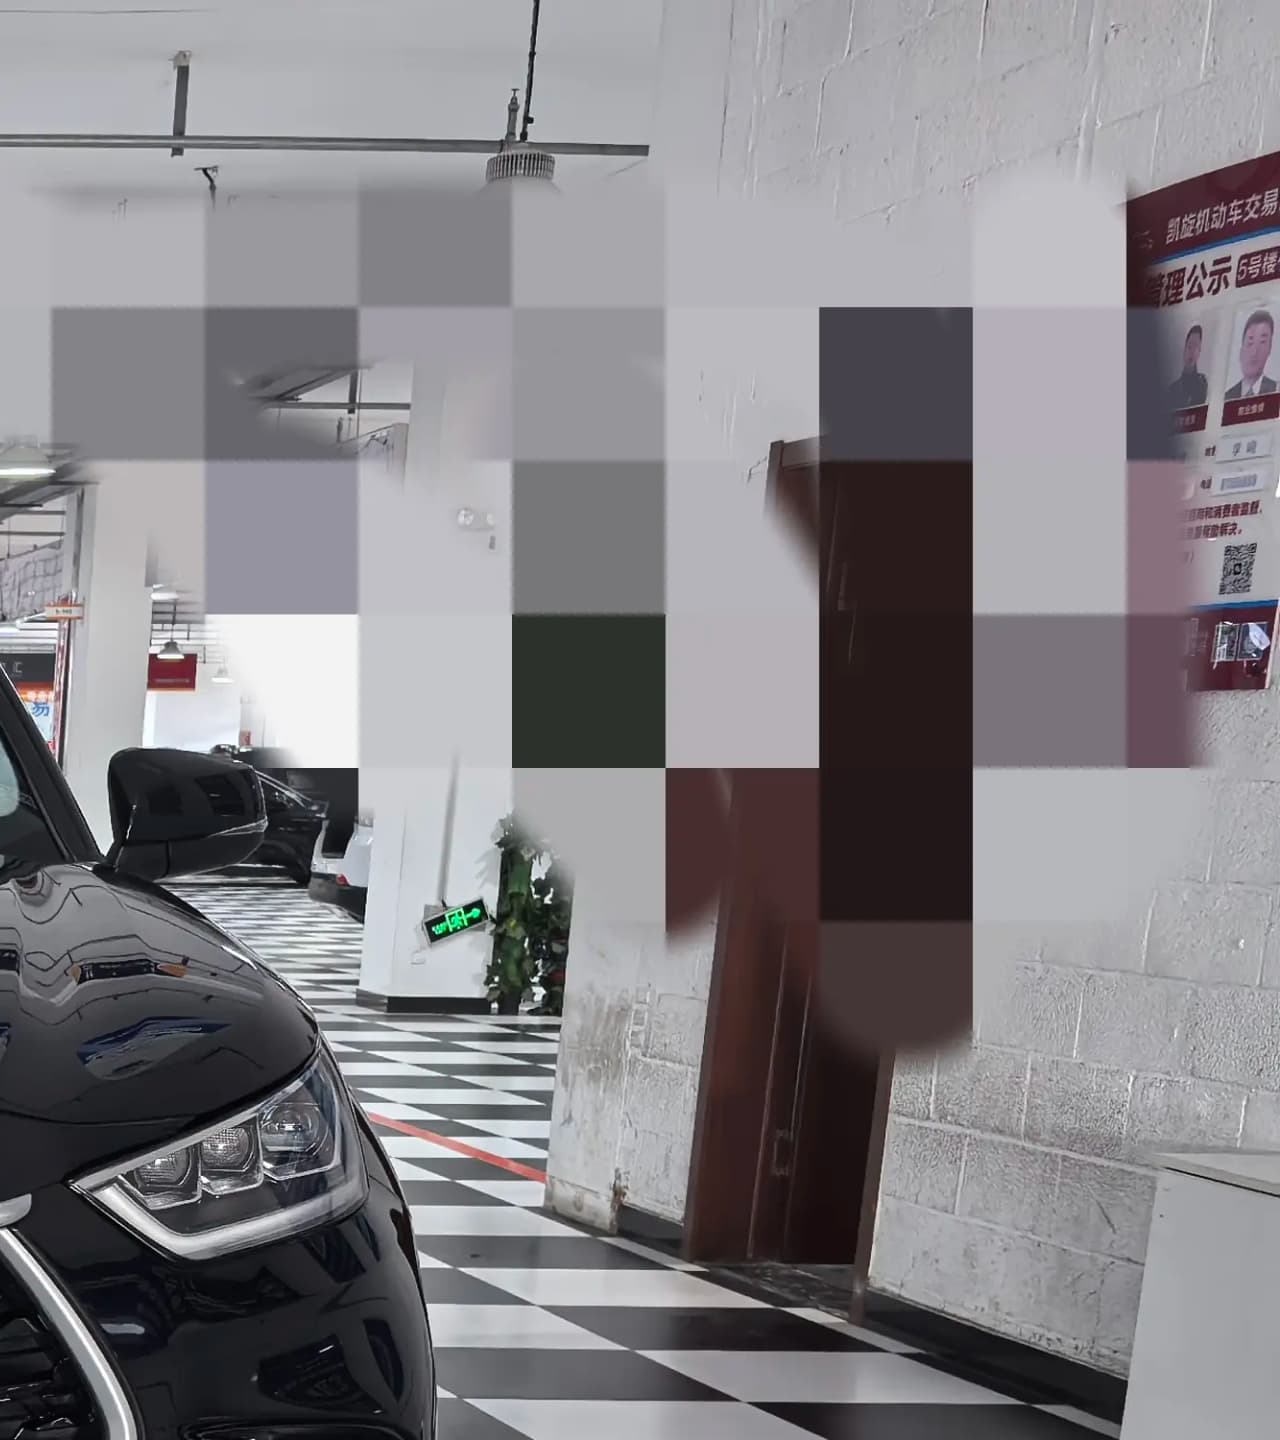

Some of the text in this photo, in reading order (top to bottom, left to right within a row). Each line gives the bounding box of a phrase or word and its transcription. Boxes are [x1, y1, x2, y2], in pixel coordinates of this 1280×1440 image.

[1165, 188, 1280, 245] 凯旋机动车交易
[1237, 250, 1280, 281] 5号楼
